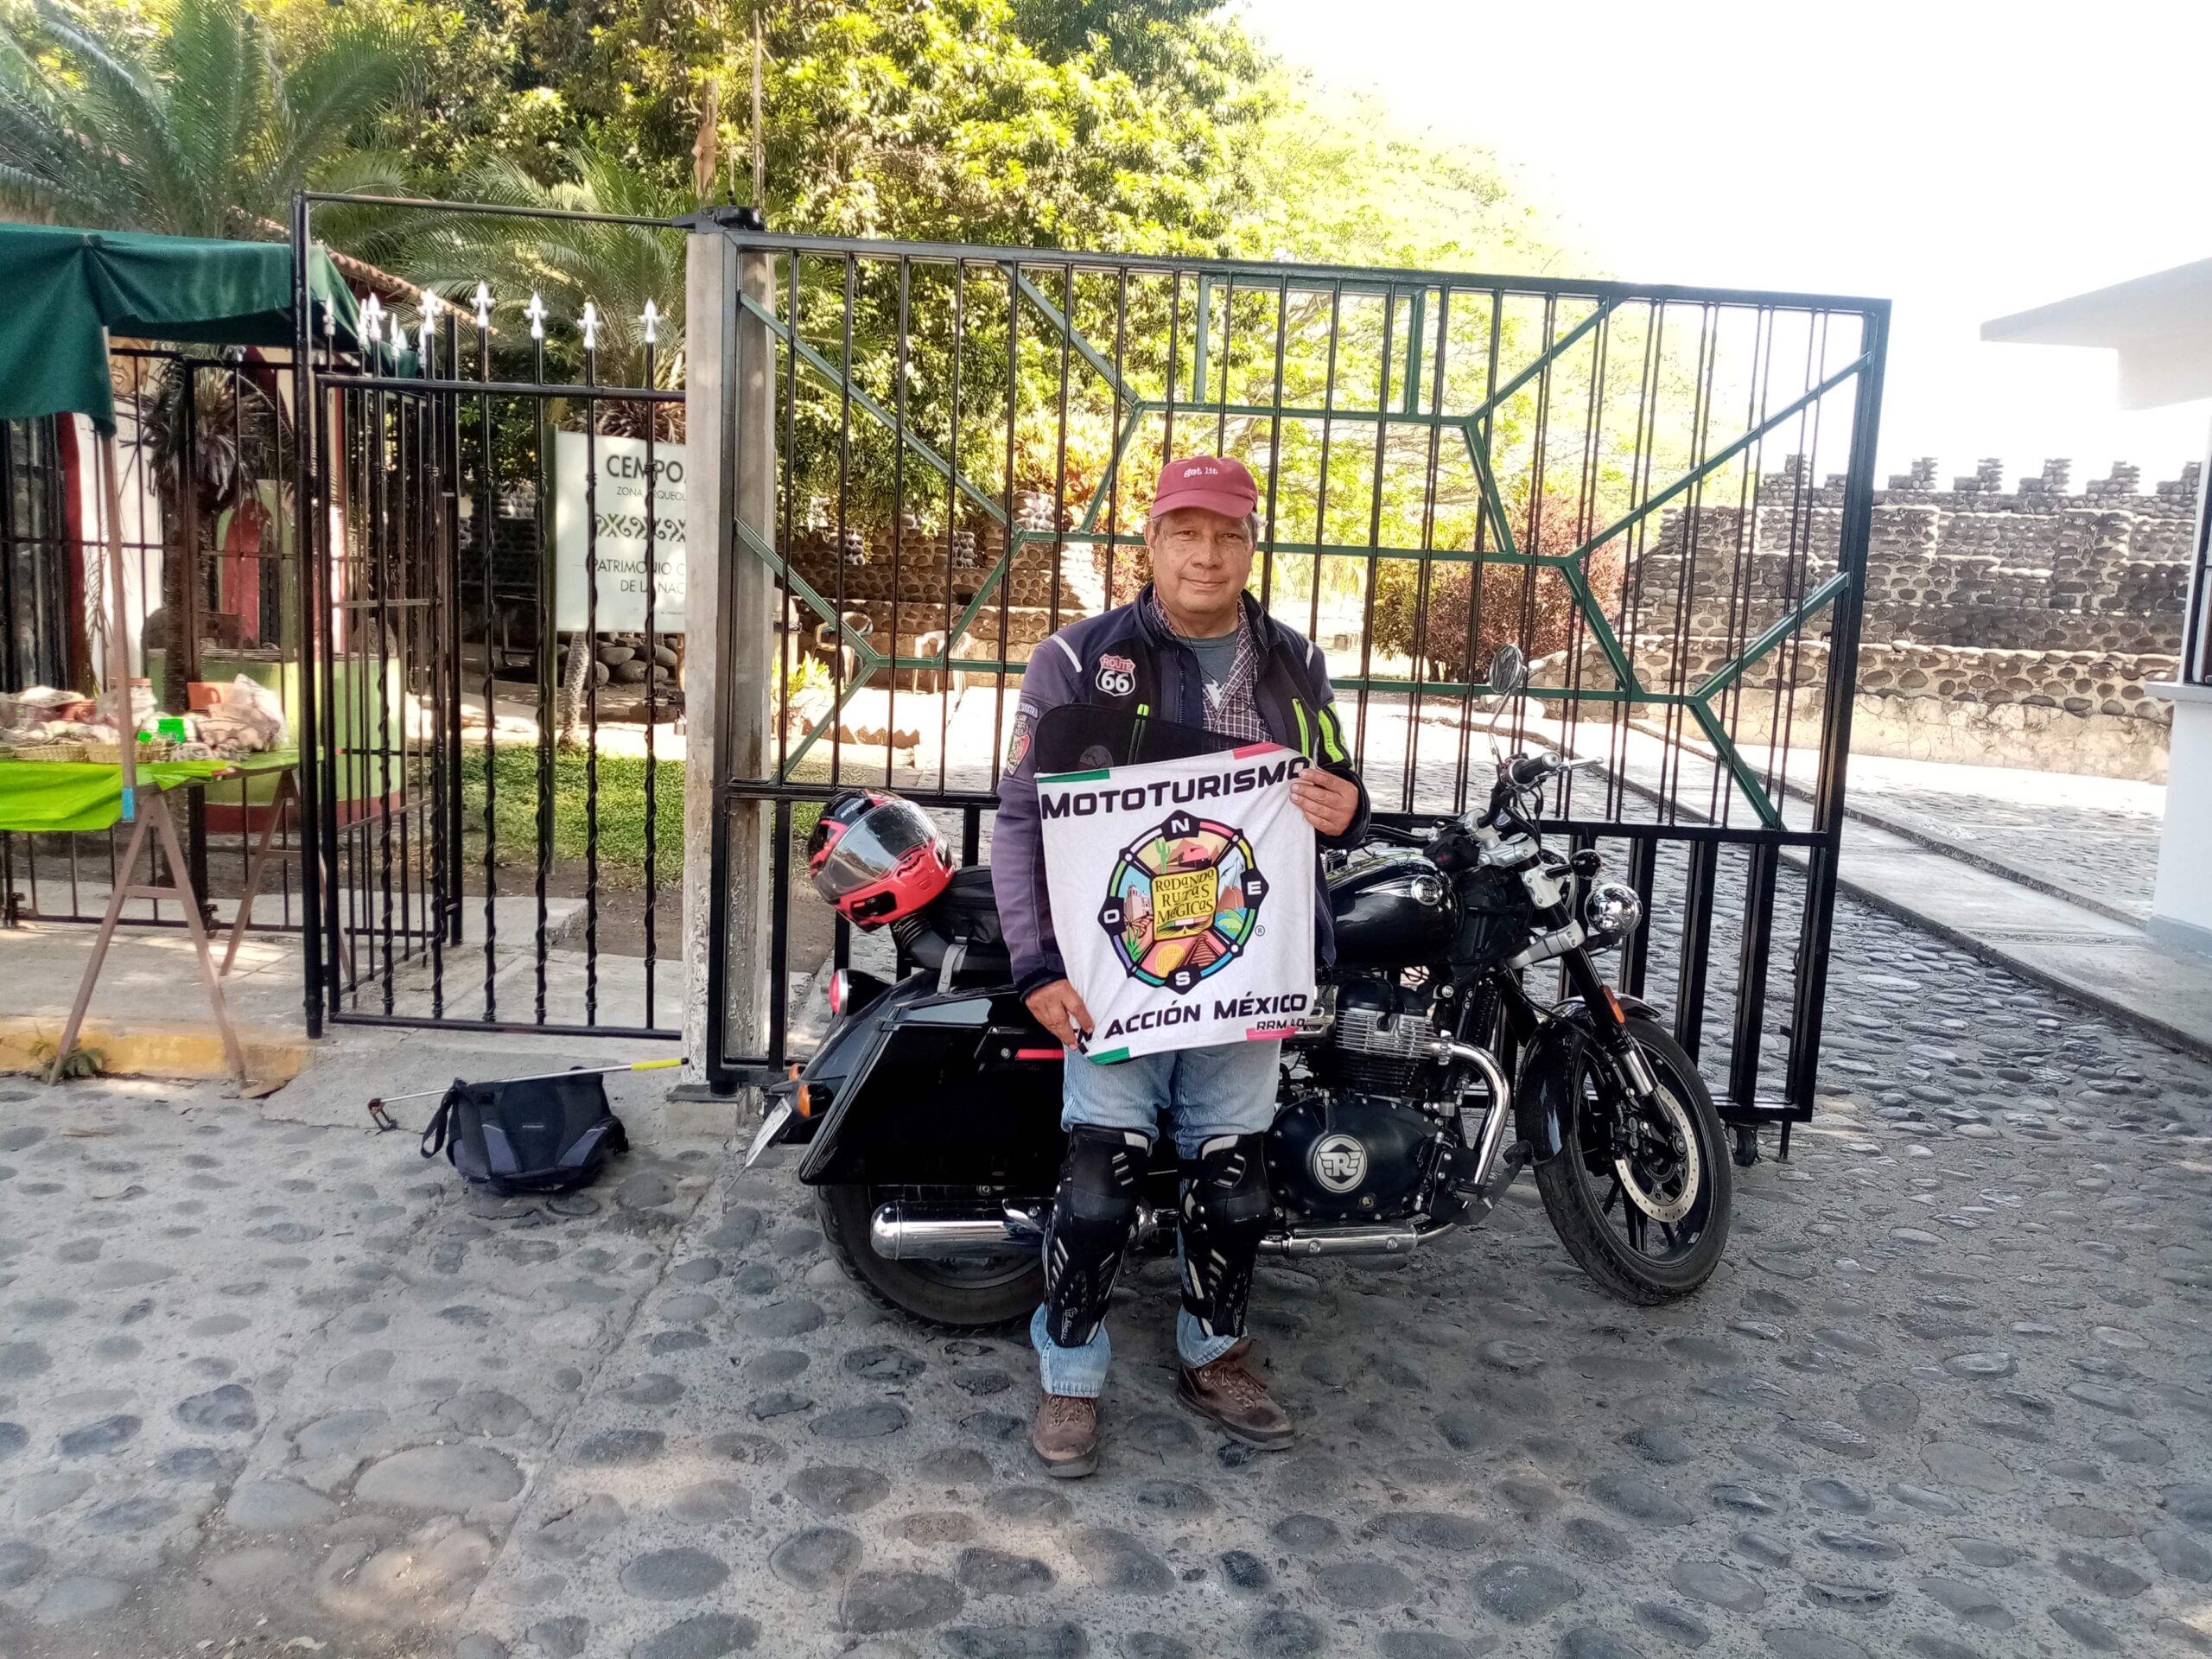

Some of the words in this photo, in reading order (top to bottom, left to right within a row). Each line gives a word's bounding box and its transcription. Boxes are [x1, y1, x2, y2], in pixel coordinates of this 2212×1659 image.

[1184, 467, 1202, 478] get
[616, 486, 643, 497] ZONA
[620, 580, 636, 592] DE
[1103, 658, 1132, 671] ROUTE
[1102, 671, 1129, 692] 66
[1040, 756, 1311, 820] MOTOTURISMO
[1171, 817, 1190, 834] N
[1247, 880, 1262, 895] E
[1103, 909, 1120, 925] O
[1175, 971, 1191, 987] S
[1104, 999, 1201, 1040] ACCIÓN
[1213, 991, 1307, 1020] MÉXICO
[1256, 1020, 1287, 1031] RRM
